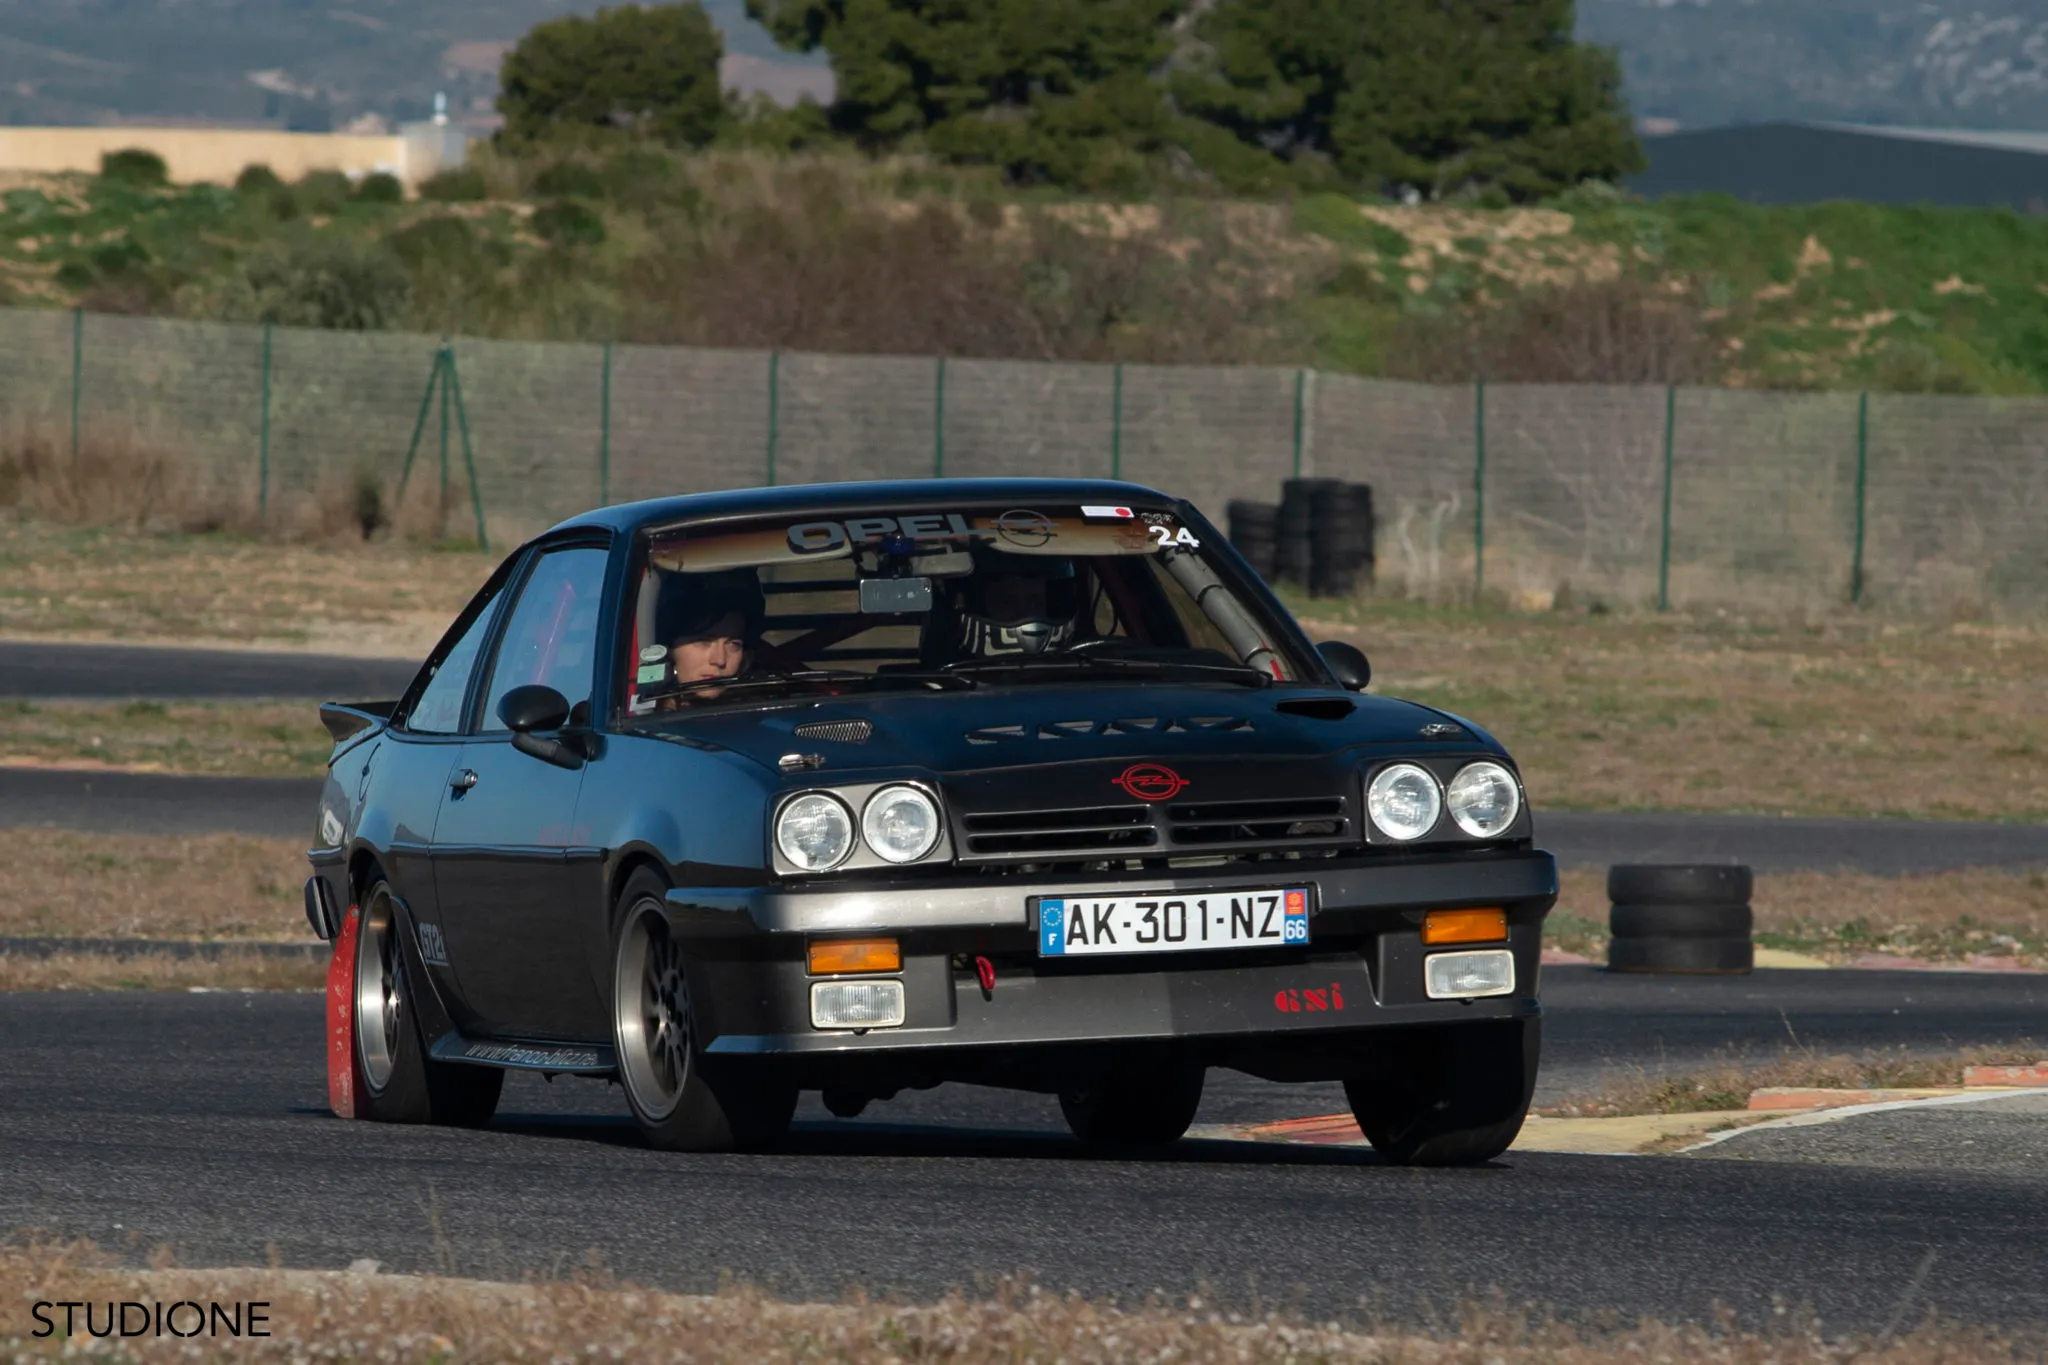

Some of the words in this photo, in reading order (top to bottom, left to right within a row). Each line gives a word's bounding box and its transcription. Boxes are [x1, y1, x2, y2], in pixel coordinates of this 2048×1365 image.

[787, 514, 995, 547] OPEL
[1149, 525, 1200, 548] 24
[1066, 897, 1280, 945] AK-301-NZ
[1286, 919, 1306, 940] 66
[1048, 932, 1058, 946] F
